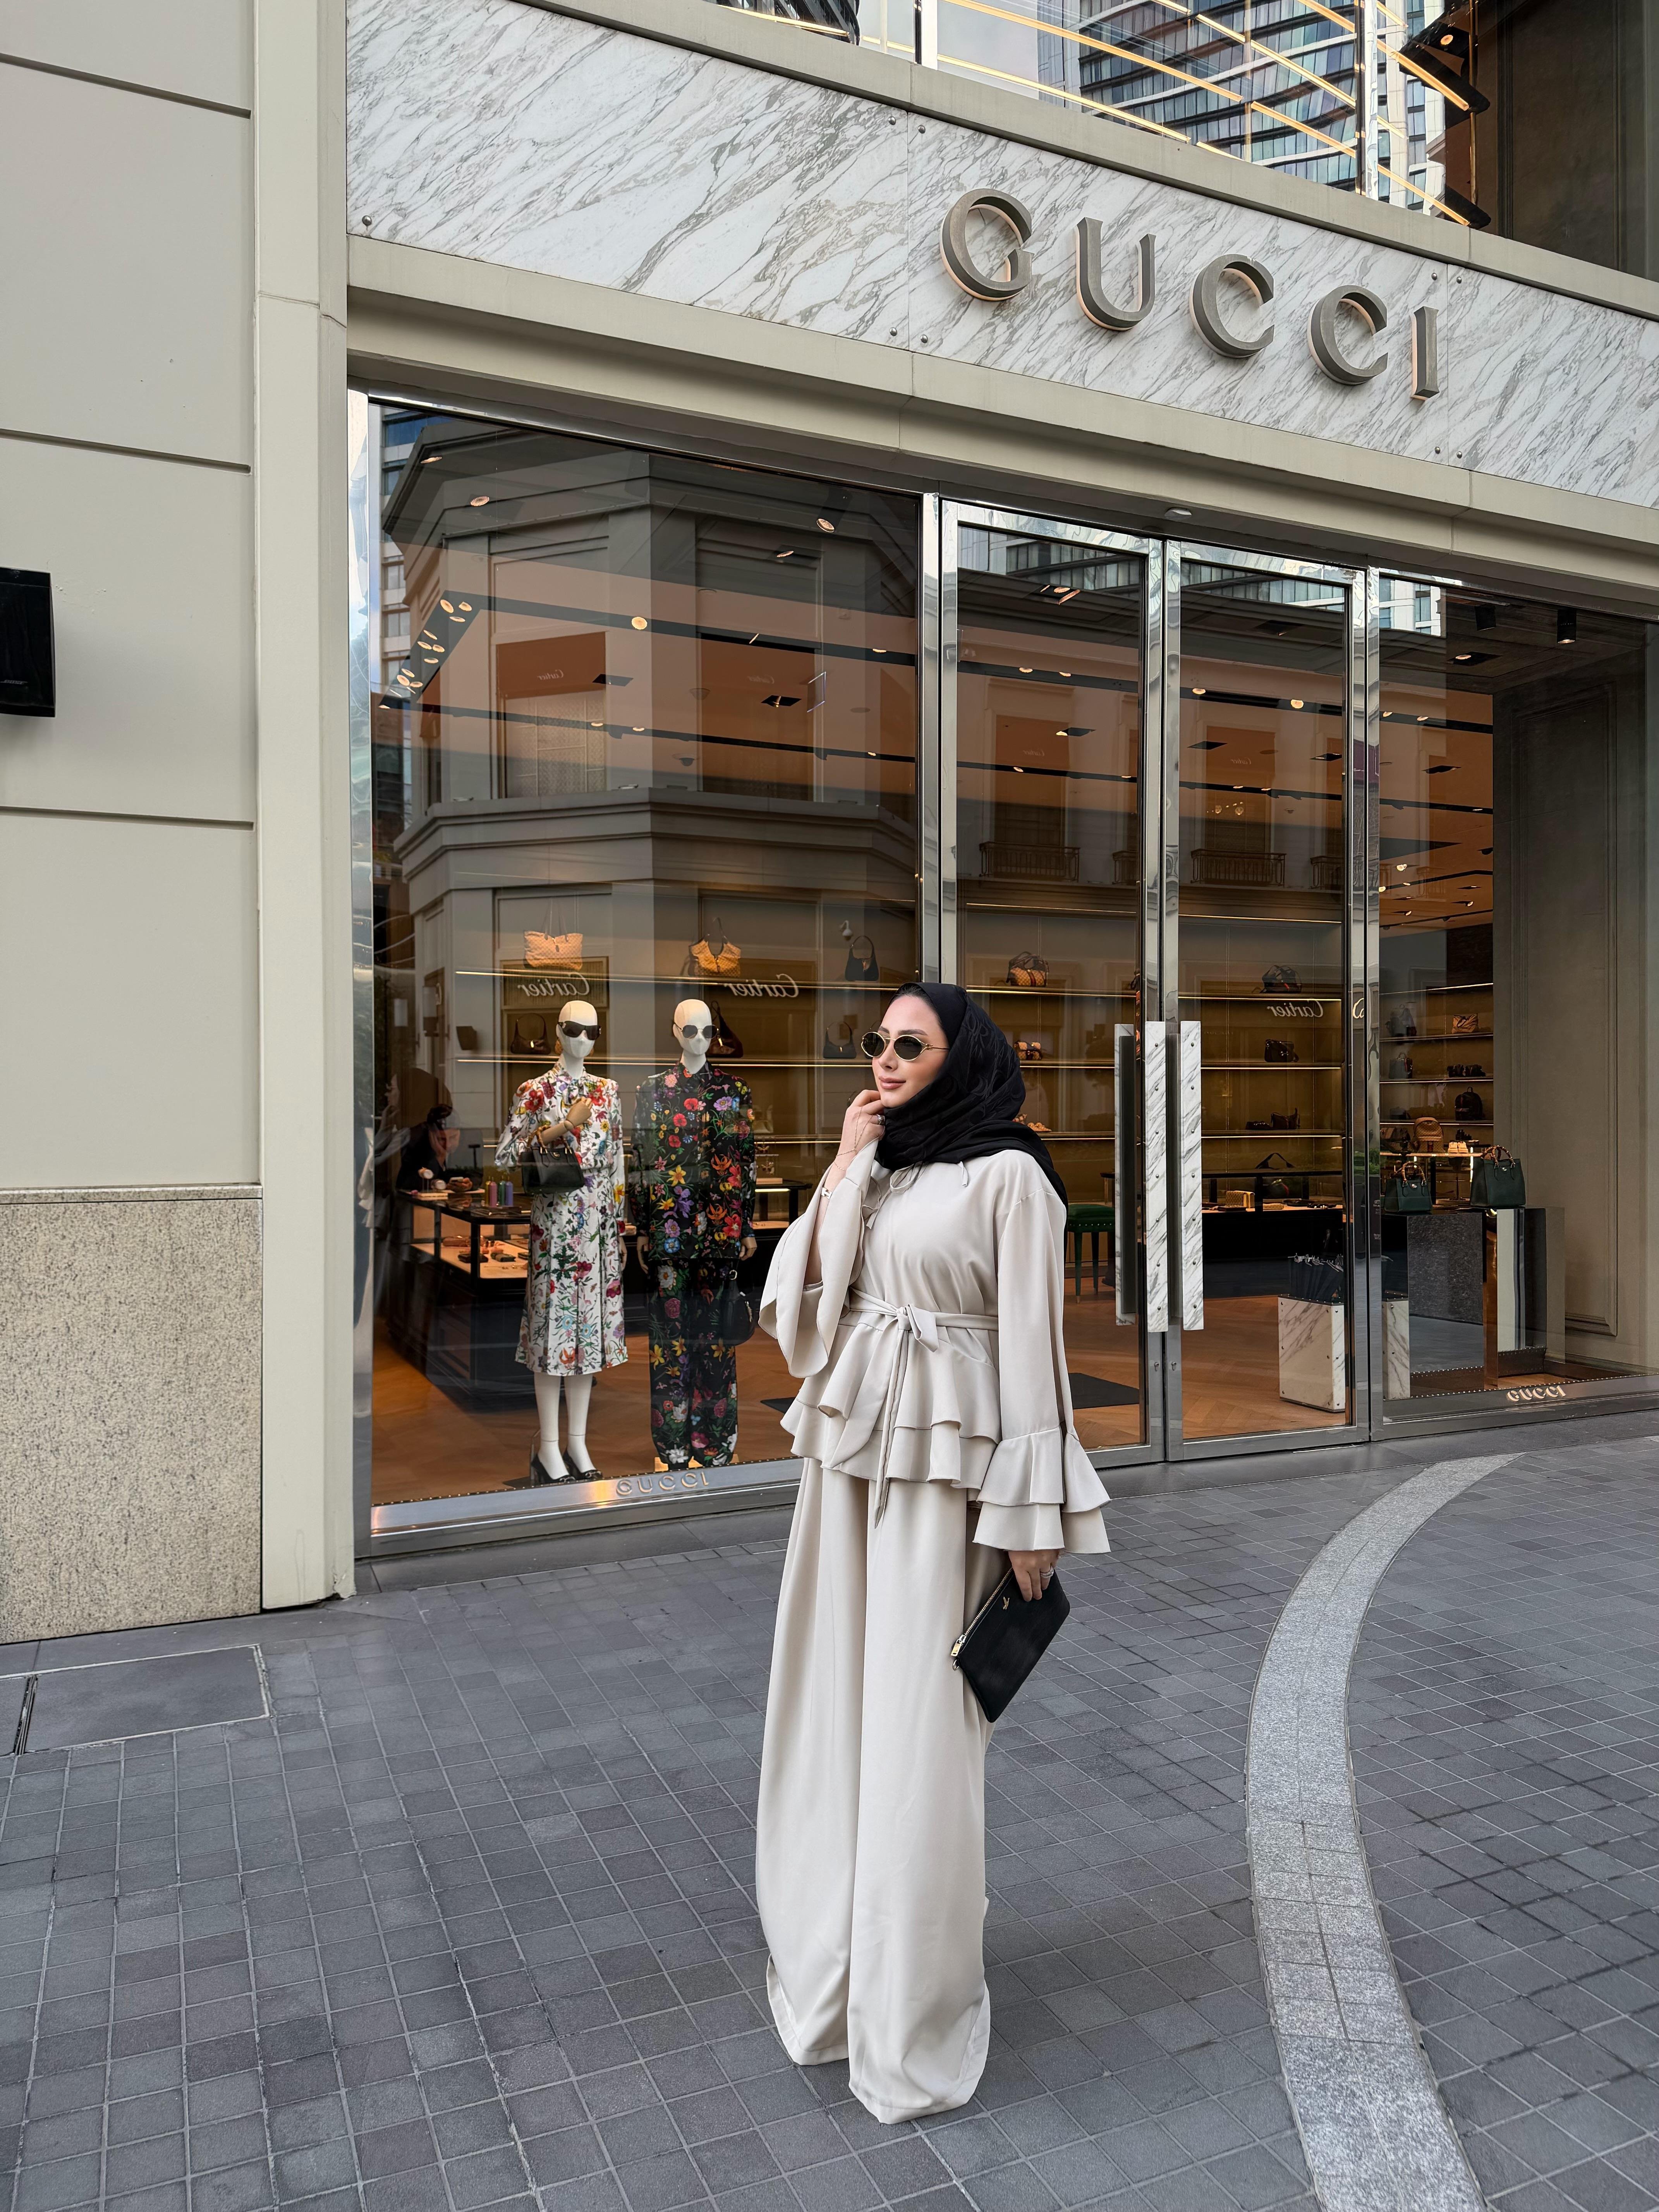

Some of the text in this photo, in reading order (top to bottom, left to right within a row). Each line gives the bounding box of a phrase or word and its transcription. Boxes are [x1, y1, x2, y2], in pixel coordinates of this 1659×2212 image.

[940, 188, 1440, 401] GUCCI
[1506, 1385, 1566, 1401] GUCCI
[616, 1471, 709, 1495] GUCCI
